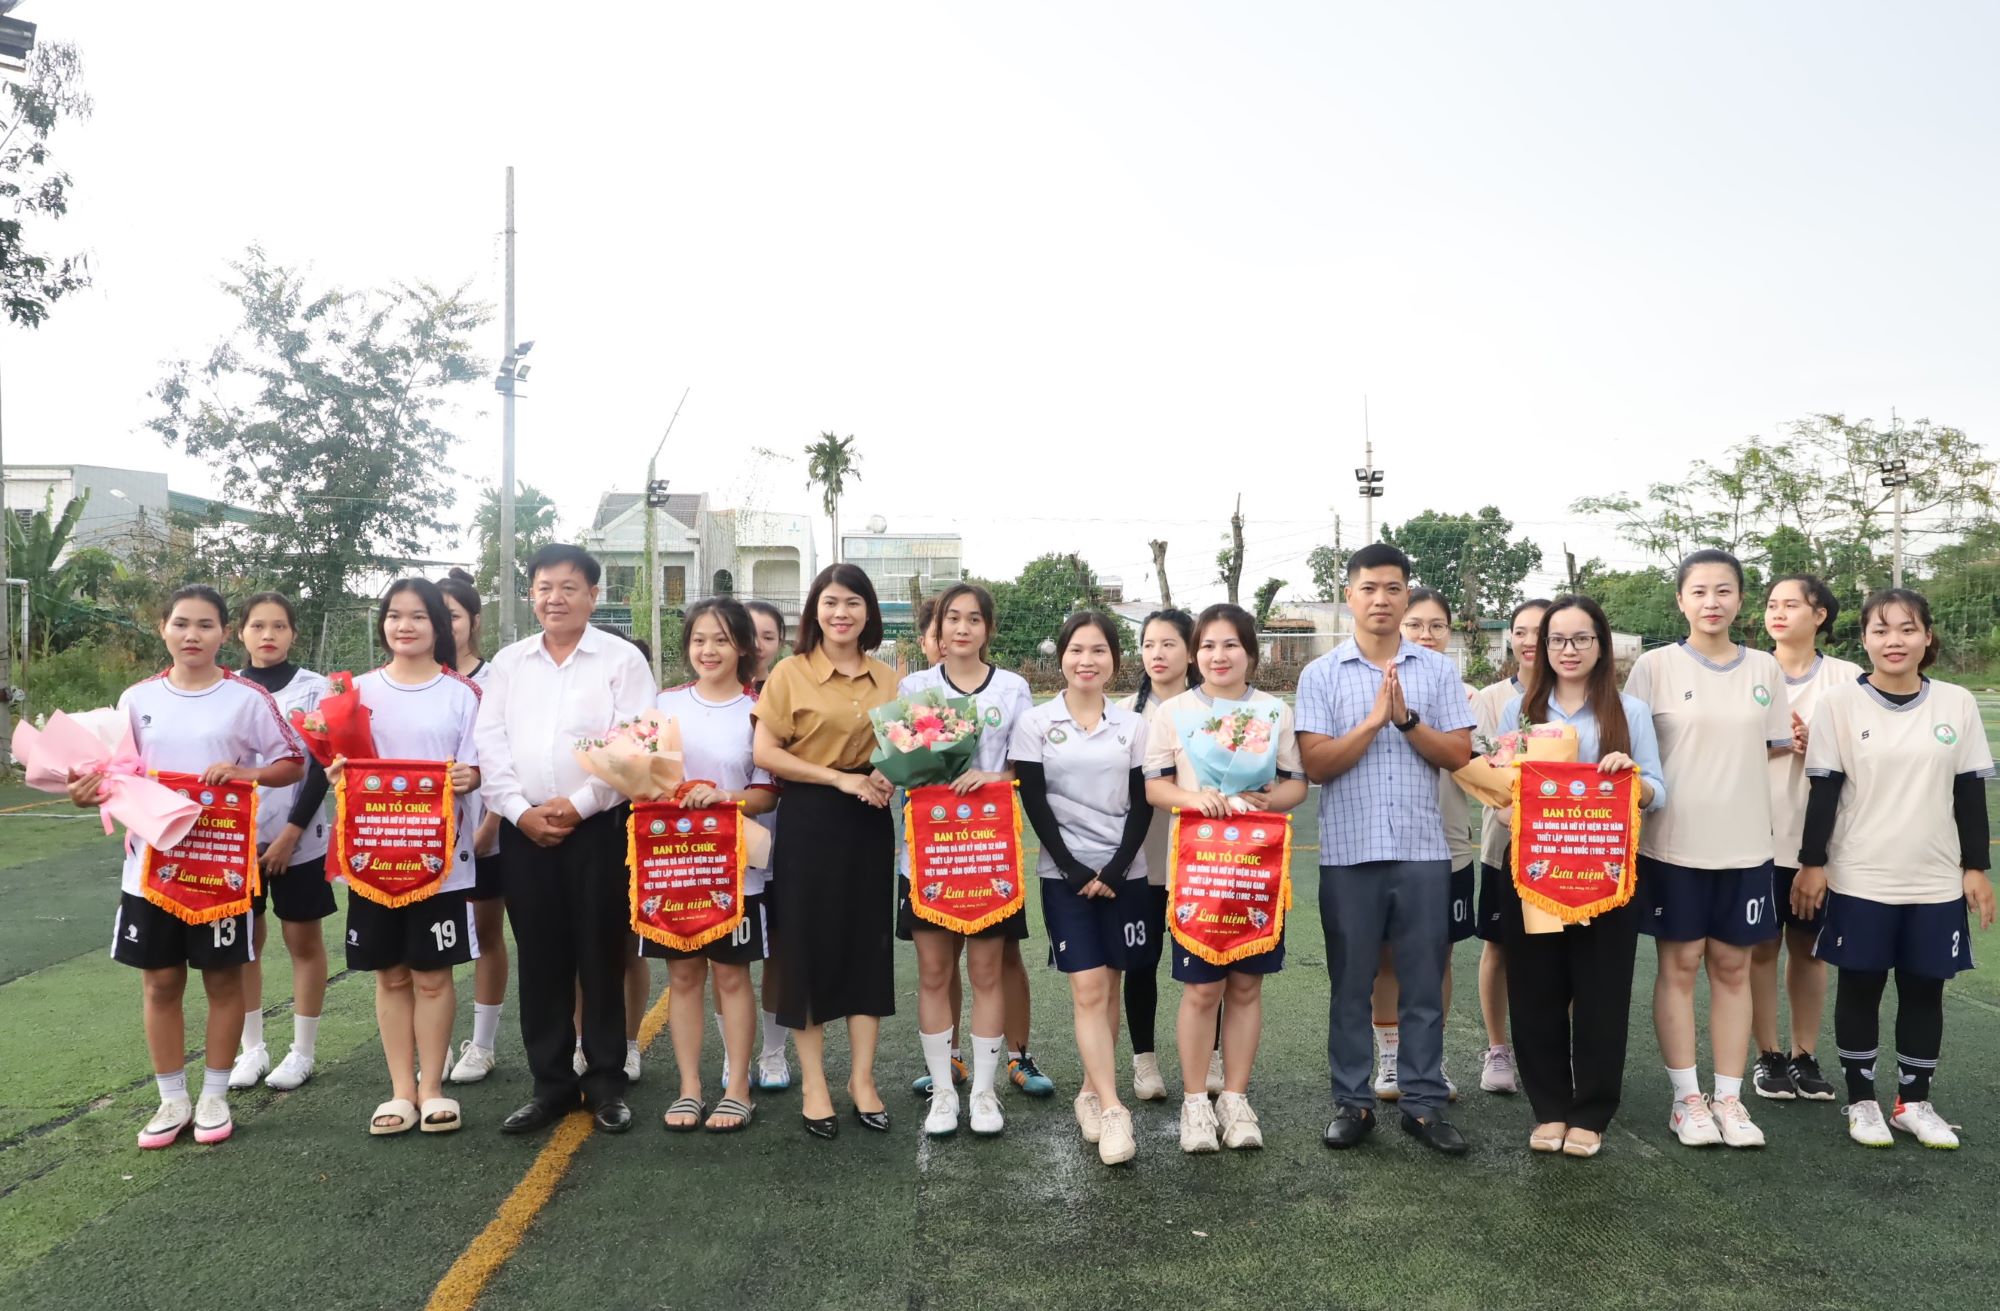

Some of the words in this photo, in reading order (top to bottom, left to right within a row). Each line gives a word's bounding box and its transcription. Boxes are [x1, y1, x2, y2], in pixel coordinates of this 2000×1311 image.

[366, 803, 386, 812] BAN
[1543, 809, 1564, 818] BAN
[1567, 805, 1581, 818] TỔ
[1584, 807, 1612, 819] CHỨC
[1602, 823, 1609, 831] 32
[934, 832, 953, 842] BAN
[956, 828, 969, 840] TỔ
[971, 828, 996, 840] CHỨC
[653, 846, 673, 855] BAN
[676, 842, 689, 854] TỔ
[691, 842, 716, 853] CHỨC
[1197, 852, 1218, 862] BAN
[1221, 850, 1234, 863] TỔ
[1236, 853, 1262, 865] CHỨC
[936, 868, 948, 876] NAM
[1550, 866, 1573, 879] Lưu
[1577, 868, 1604, 882] niệm
[943, 885, 964, 899] Lưu
[968, 886, 993, 900] niệm
[209, 917, 236, 948] 13
[430, 919, 457, 952] 19
[732, 917, 751, 946] 10
[1124, 920, 1146, 947] 03
